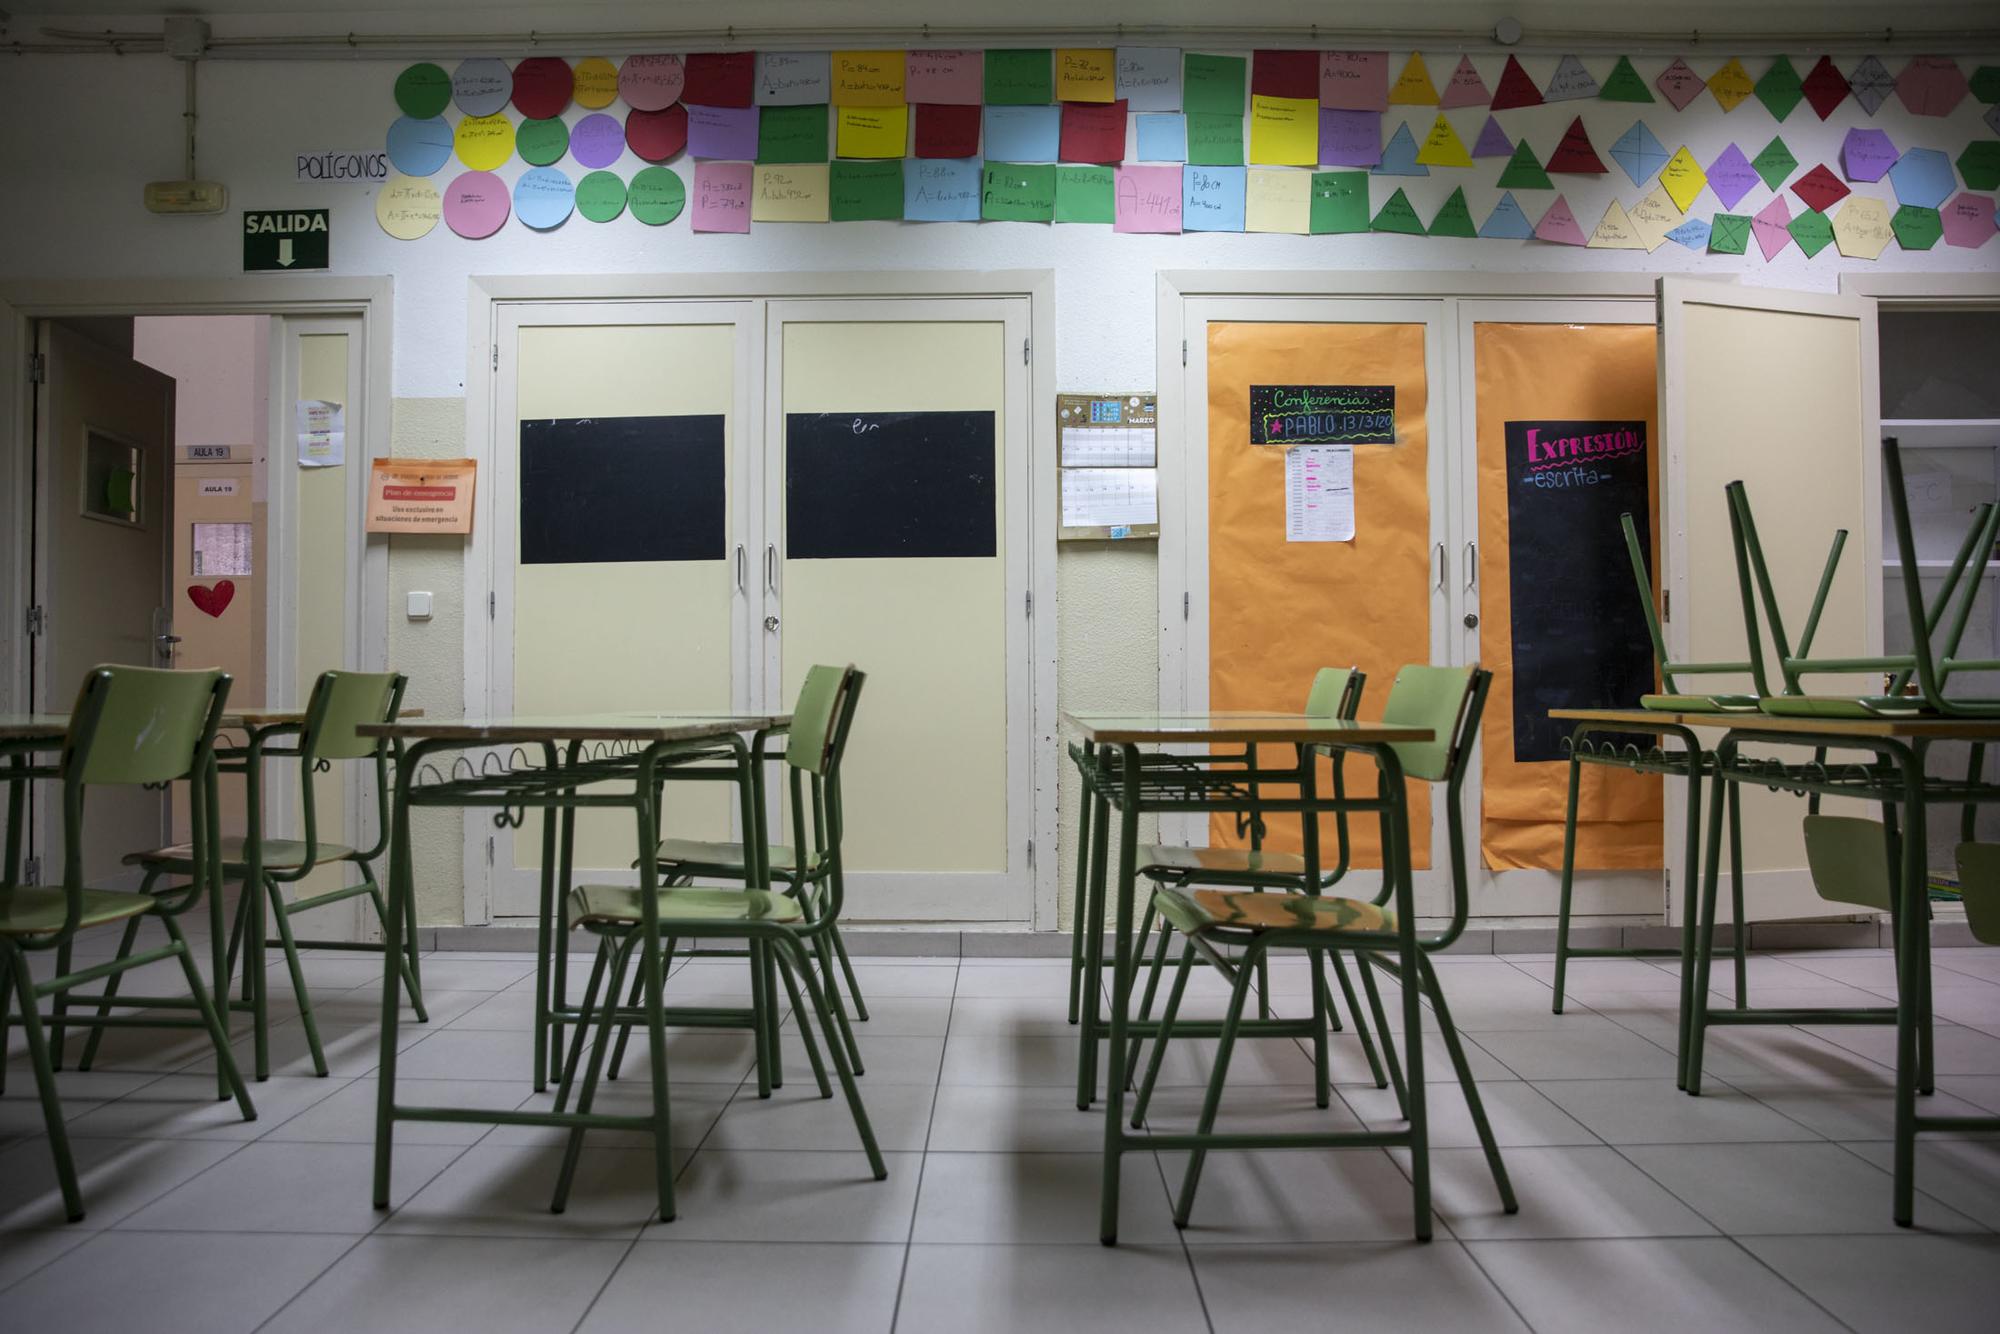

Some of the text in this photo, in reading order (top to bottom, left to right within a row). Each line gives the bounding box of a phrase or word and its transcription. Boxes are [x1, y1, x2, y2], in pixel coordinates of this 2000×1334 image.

[297, 152, 388, 179] POLÍGONOS
[246, 213, 328, 234] SALIDA
[1274, 389, 1370, 415] Conferencias
[1285, 415, 1335, 437] PABLO
[193, 447, 224, 457] AULA 19
